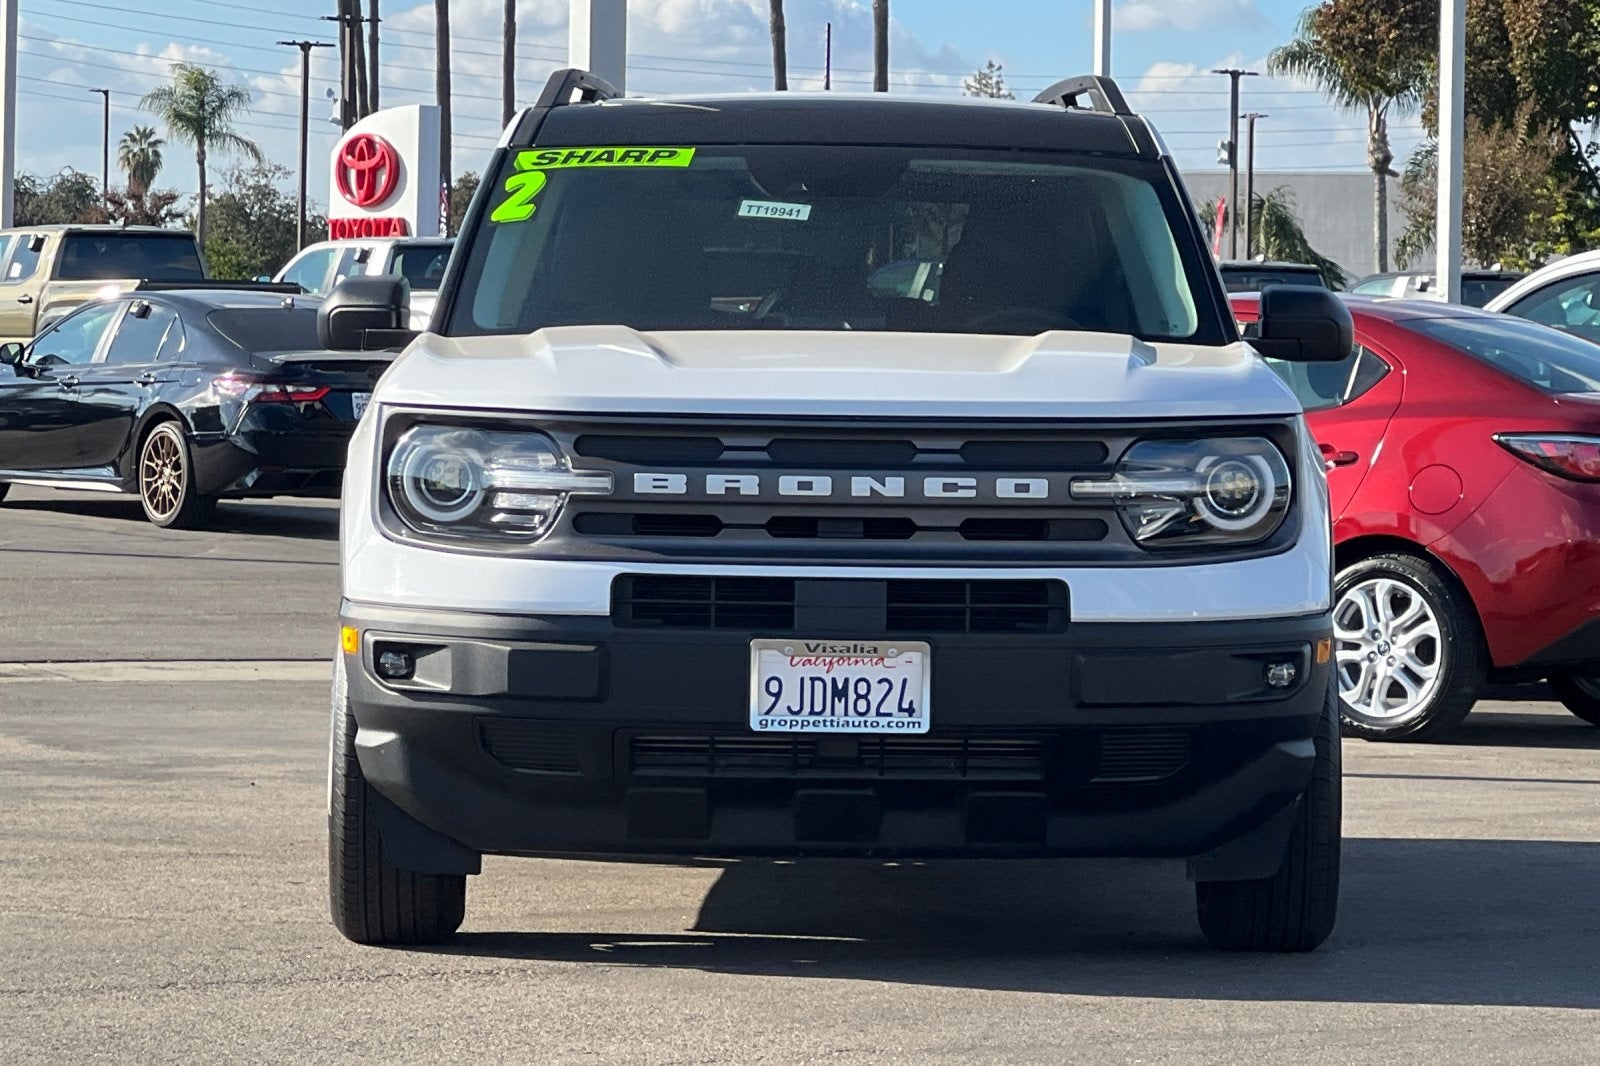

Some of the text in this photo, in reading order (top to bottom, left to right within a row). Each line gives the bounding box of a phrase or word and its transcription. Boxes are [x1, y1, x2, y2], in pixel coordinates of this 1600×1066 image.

[531, 149, 680, 166] SHARP
[490, 170, 547, 223] 2
[746, 204, 801, 218] TT19941
[326, 217, 404, 241] TOYOTA
[633, 472, 1049, 499] BRONCO
[804, 642, 879, 655] Visalia
[789, 656, 897, 674] California
[763, 675, 917, 717] 9JDM824
[758, 718, 922, 730] groppettiauto.com
